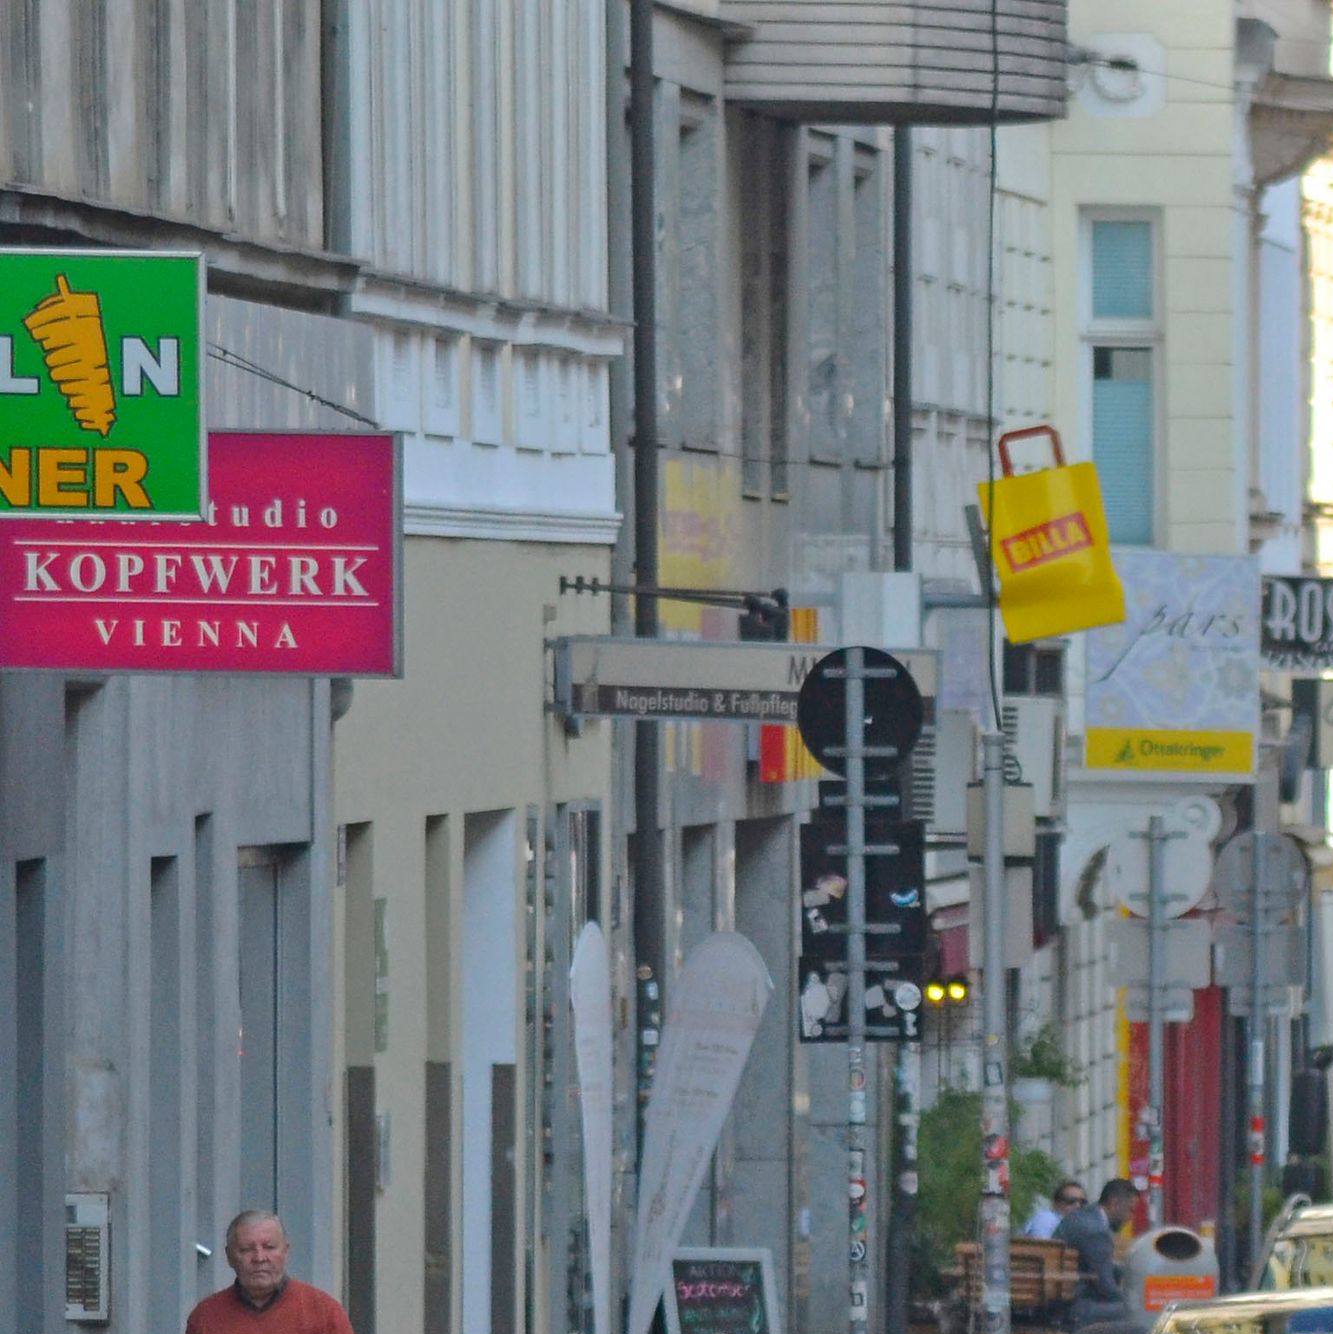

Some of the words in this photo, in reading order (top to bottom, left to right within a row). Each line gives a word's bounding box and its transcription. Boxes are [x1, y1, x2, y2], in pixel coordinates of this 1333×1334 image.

[1009, 521, 1088, 566] BILLA
[24, 551, 370, 598] KOPFWERK
[95, 619, 299, 649] VIENNA
[615, 689, 709, 715] Nagelstudio
[714, 693, 726, 713] &
[731, 693, 799, 721] Fußpfleg
